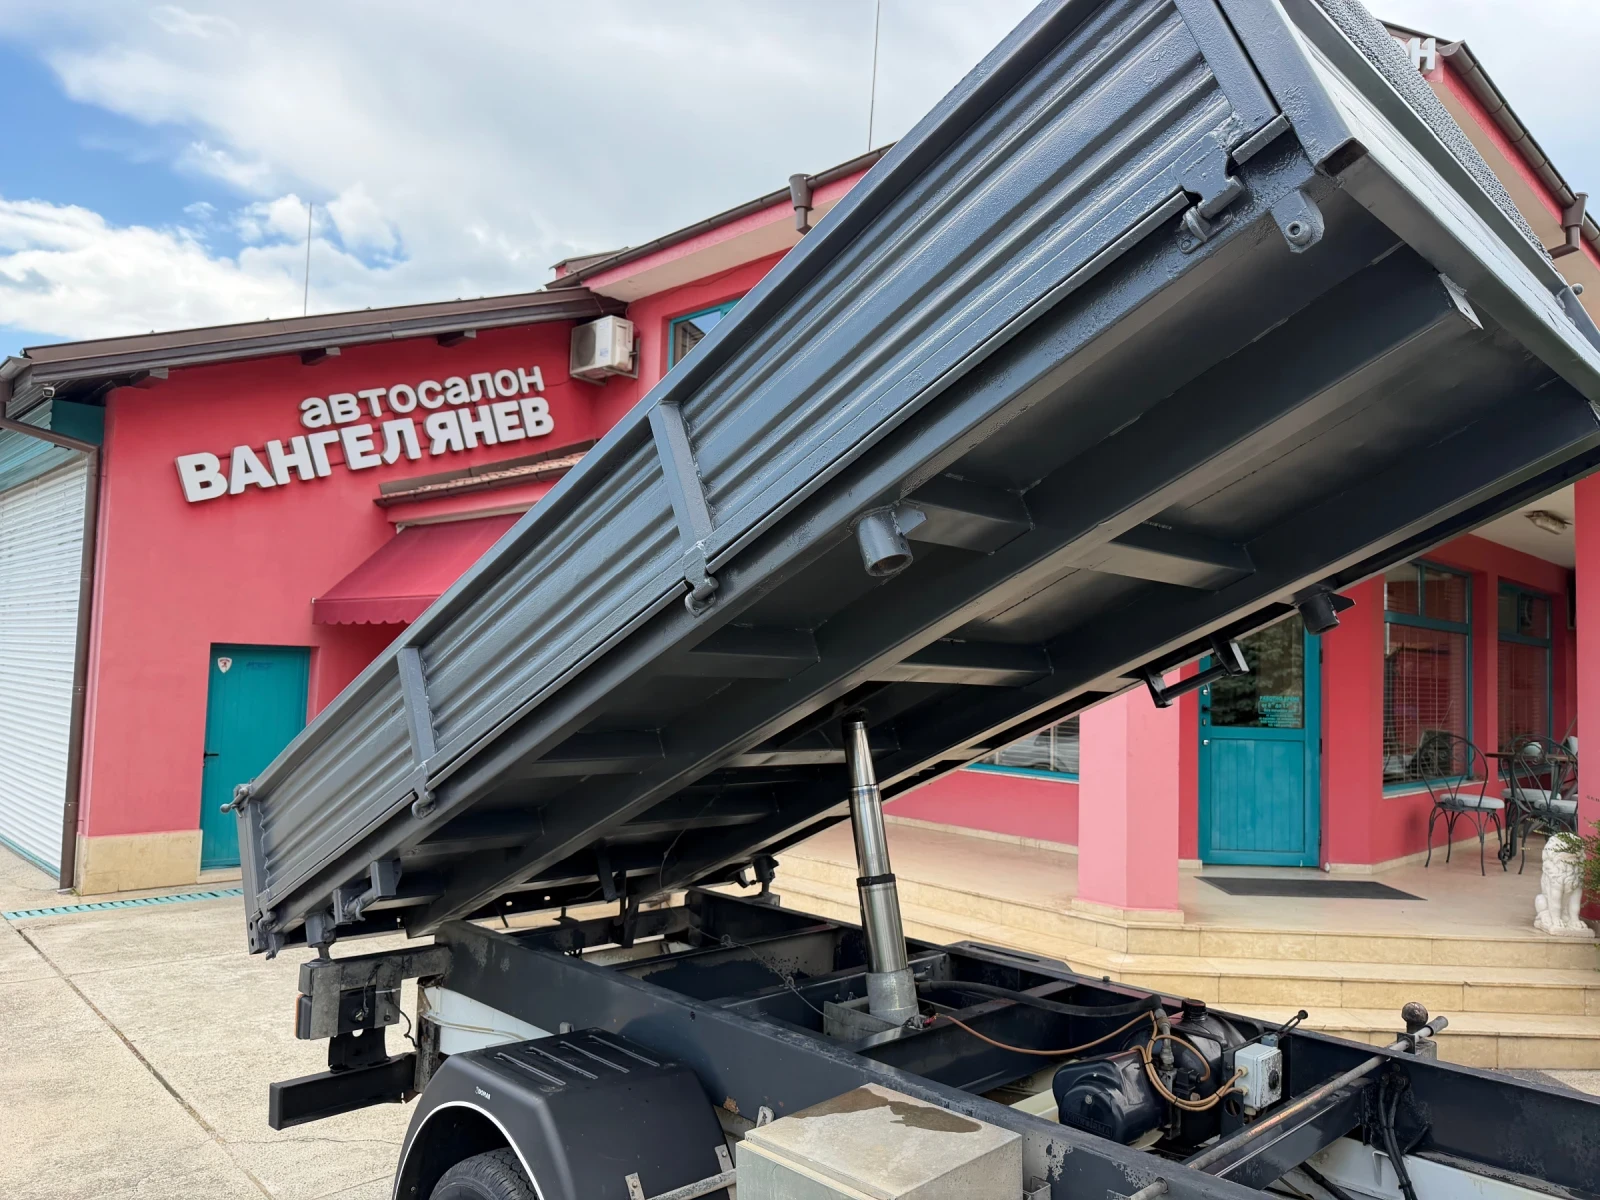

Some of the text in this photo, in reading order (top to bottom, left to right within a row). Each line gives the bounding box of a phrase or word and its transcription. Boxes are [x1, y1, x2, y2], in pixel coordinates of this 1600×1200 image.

[300, 365, 545, 428] автосалон
[175, 396, 555, 503] ВАНГЕЛ ЯНЕВ
